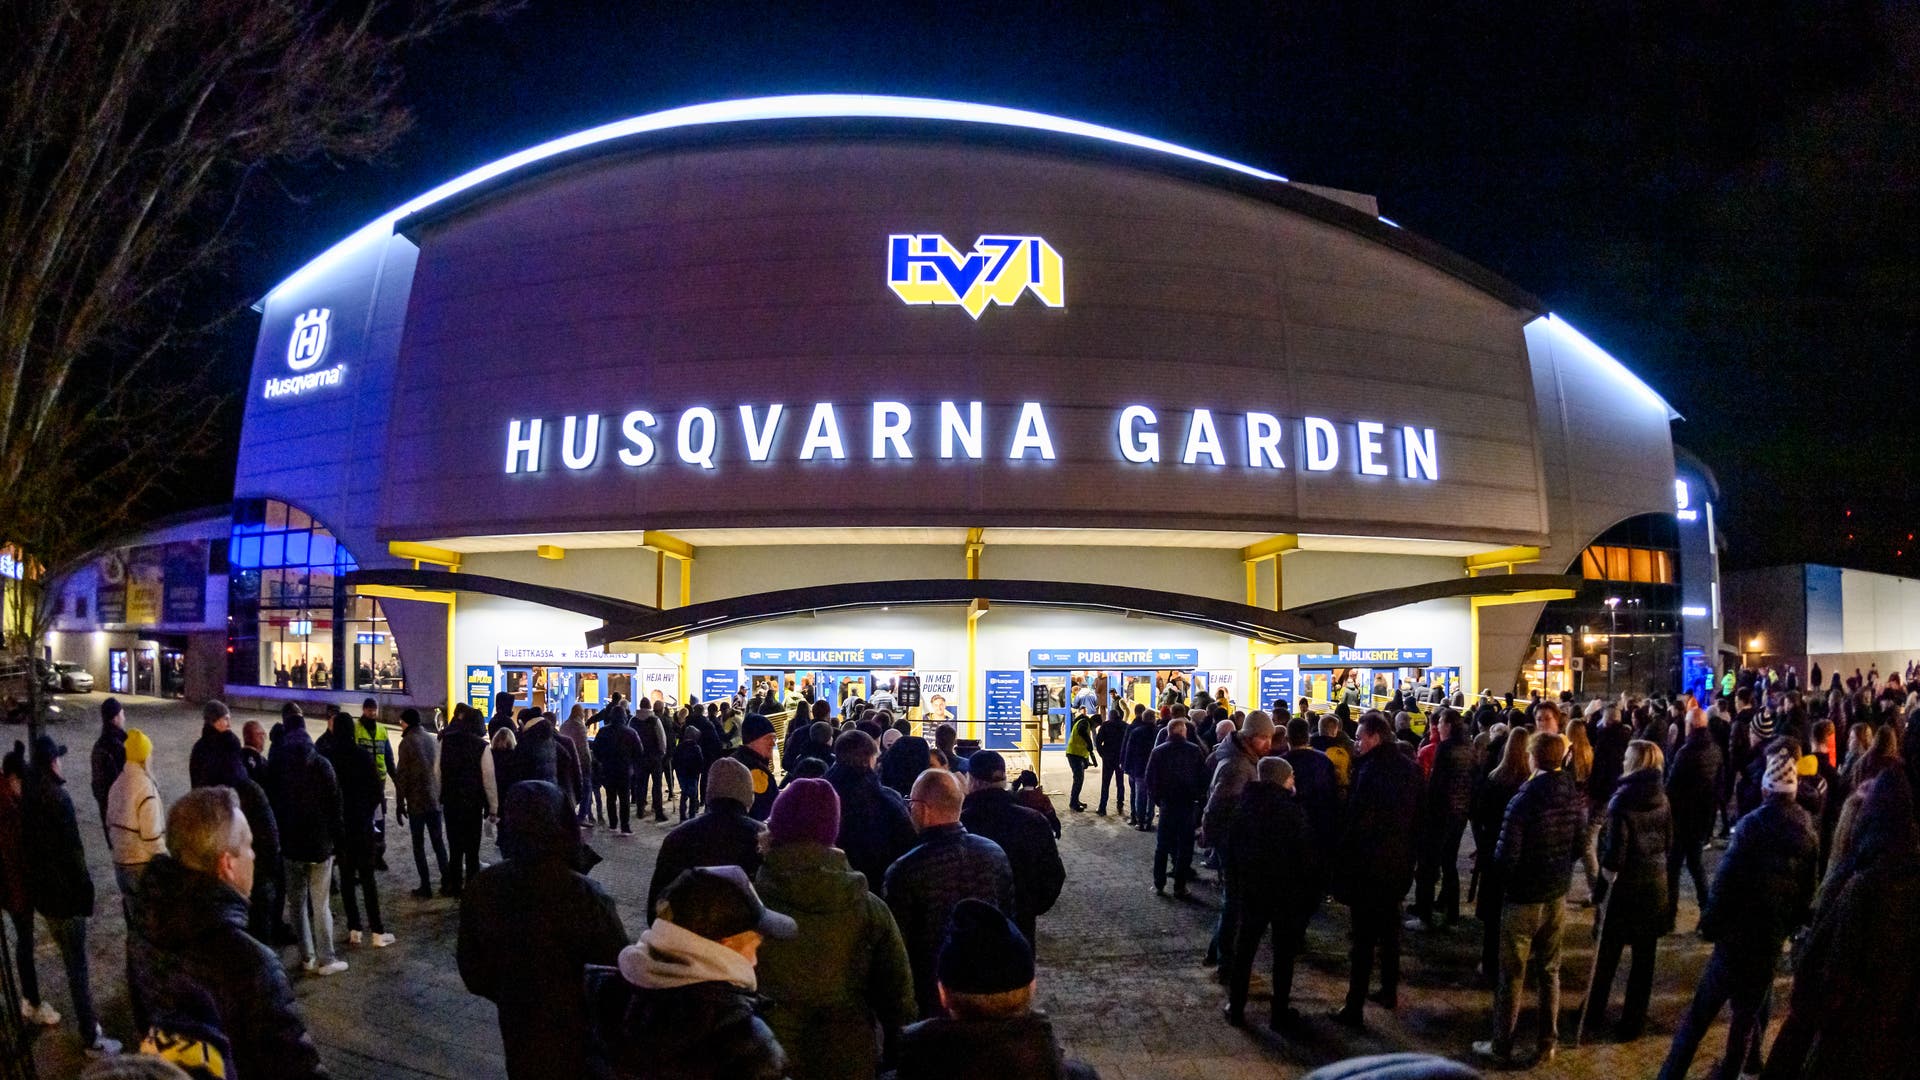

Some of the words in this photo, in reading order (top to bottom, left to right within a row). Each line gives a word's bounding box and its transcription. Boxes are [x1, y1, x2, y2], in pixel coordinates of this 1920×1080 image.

[888, 235, 1064, 320] HV71
[264, 367, 342, 399] Husqvarna
[505, 400, 1056, 473] HUSQVARNA
[1119, 405, 1438, 480] GARDEN
[504, 649, 554, 658] BILJETTKASSA
[788, 649, 864, 662] PUBLIKENTRÉ
[1078, 649, 1152, 663] PUBLIKENTRÉ
[1339, 648, 1398, 661] PUBLIKENTRÉ
[646, 673, 662, 682] HEJA
[925, 674, 933, 683] IN
[934, 674, 952, 683] MED
[922, 683, 954, 693] PUCKEN!
